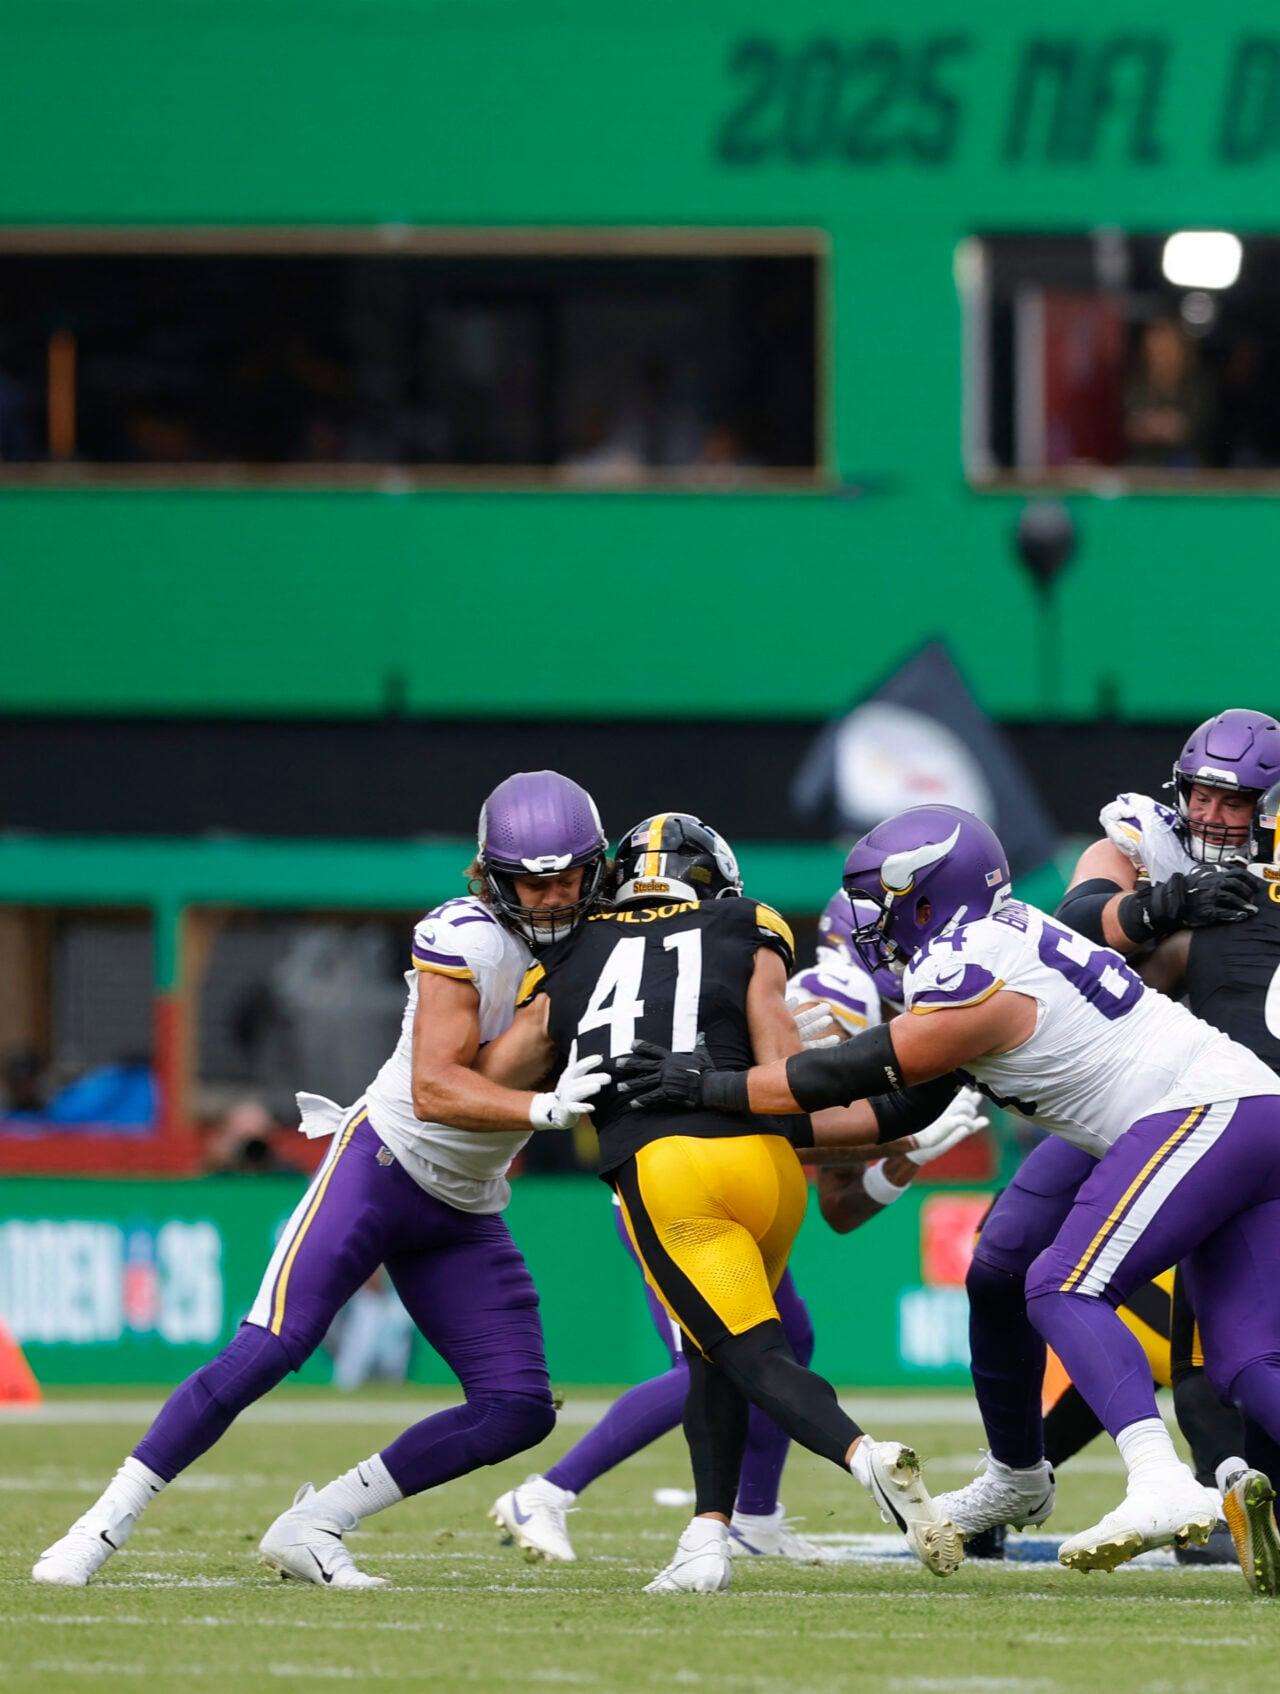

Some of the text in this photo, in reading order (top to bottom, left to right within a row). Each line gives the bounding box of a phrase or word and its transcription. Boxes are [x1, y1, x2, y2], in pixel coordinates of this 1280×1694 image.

[714, 34, 972, 168] 2025
[1005, 34, 1174, 166] NFL
[633, 881, 671, 895] Steelers
[634, 853, 668, 877] 41
[577, 927, 702, 1059] 41
